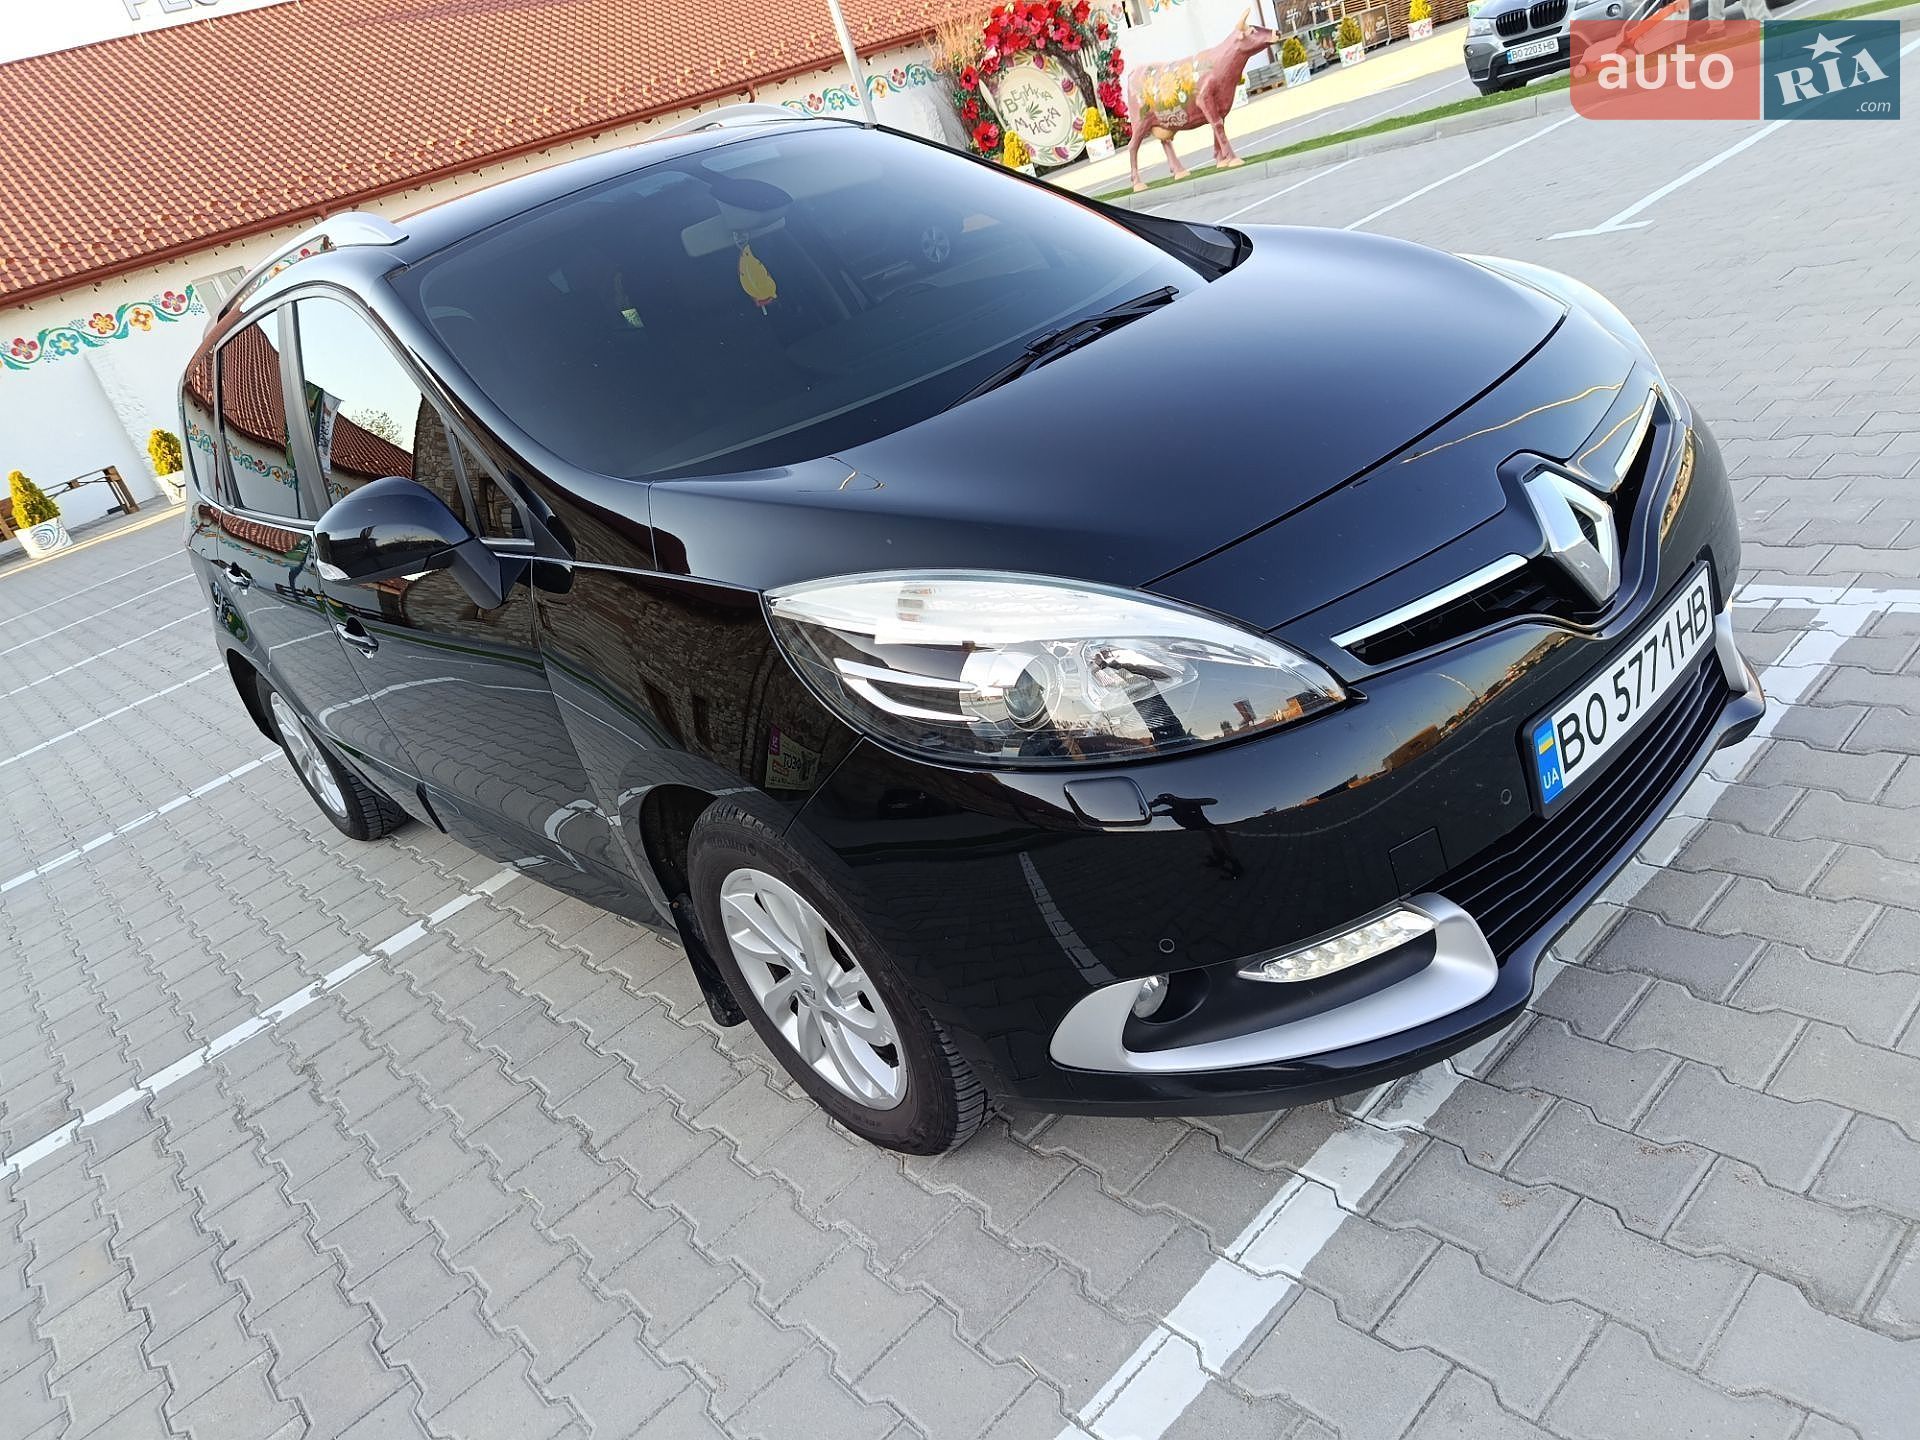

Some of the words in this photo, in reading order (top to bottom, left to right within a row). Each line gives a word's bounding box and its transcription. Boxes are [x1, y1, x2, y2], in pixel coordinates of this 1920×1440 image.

[1014, 106, 1061, 135] МИСКА
[1556, 692, 1607, 775] BO
[1543, 767, 1560, 789] UA
